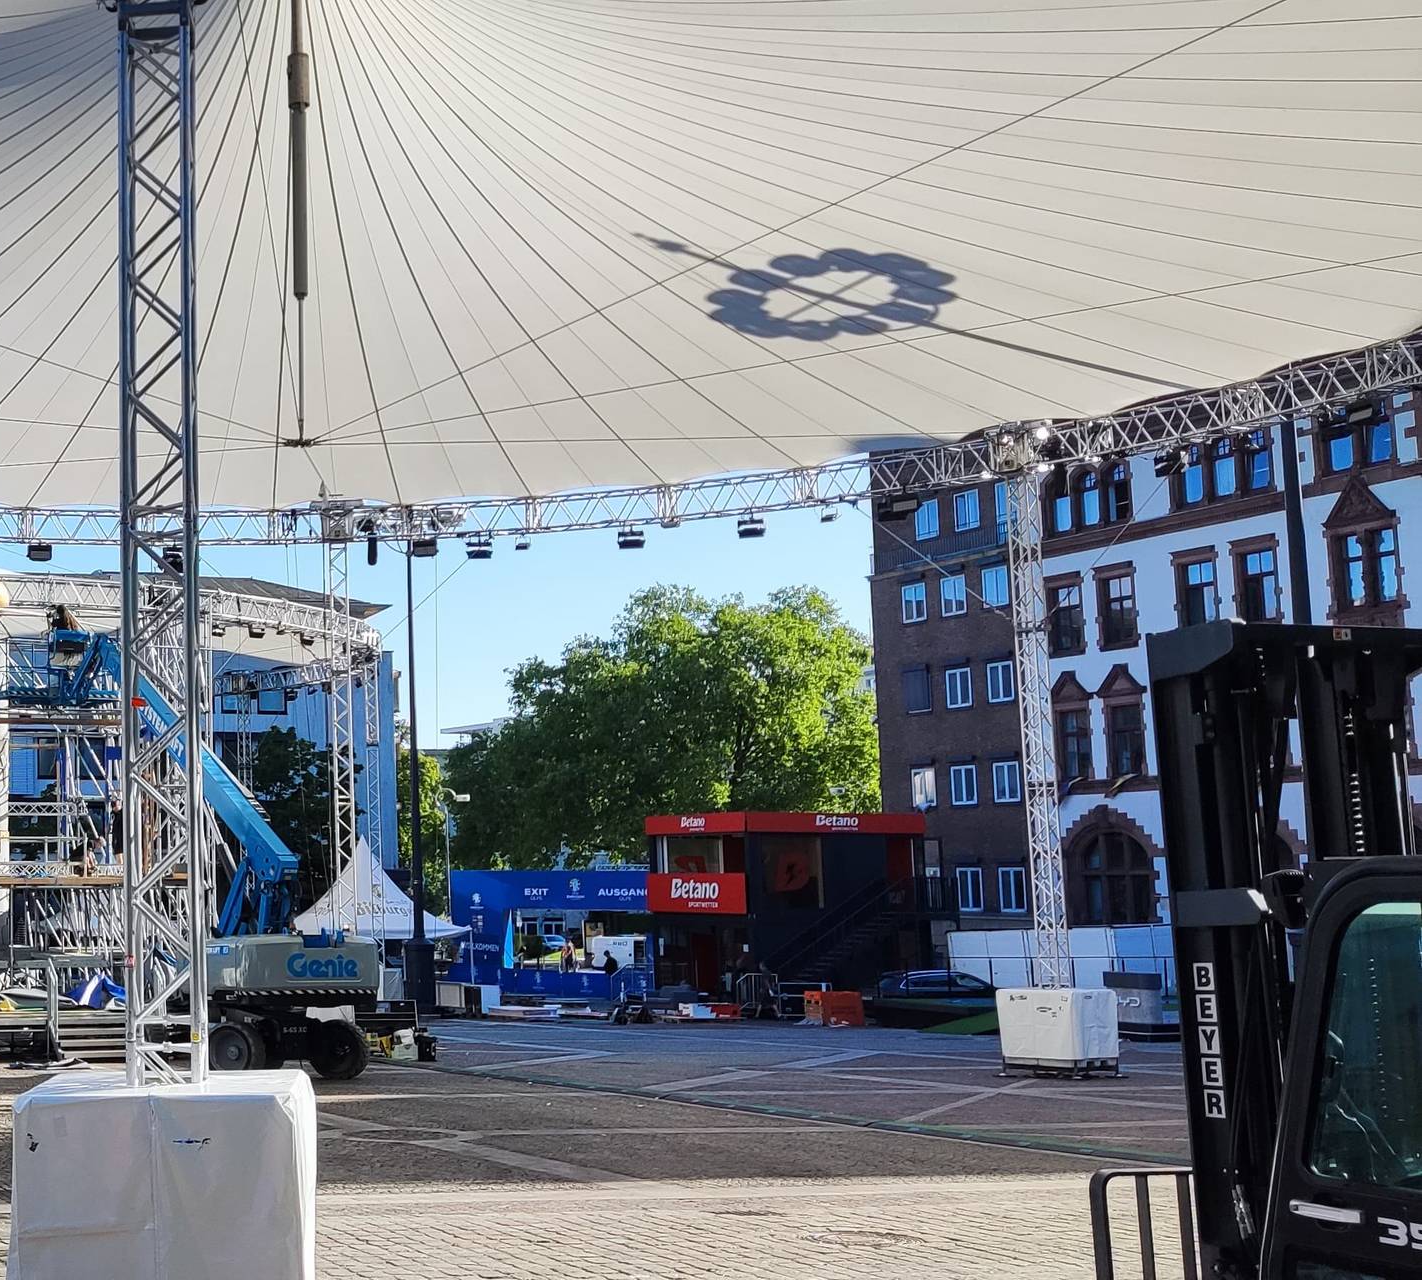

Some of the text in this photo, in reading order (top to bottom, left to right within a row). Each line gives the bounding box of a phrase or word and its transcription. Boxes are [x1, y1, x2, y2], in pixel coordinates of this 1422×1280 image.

[680, 816, 705, 828] Betano
[816, 815, 859, 826] Betano
[524, 888, 548, 896] EXIT
[671, 878, 719, 899] Betano
[286, 952, 359, 979] Genie
[1119, 995, 1141, 1007] YD
[1196, 965, 1223, 1115] BEYER
